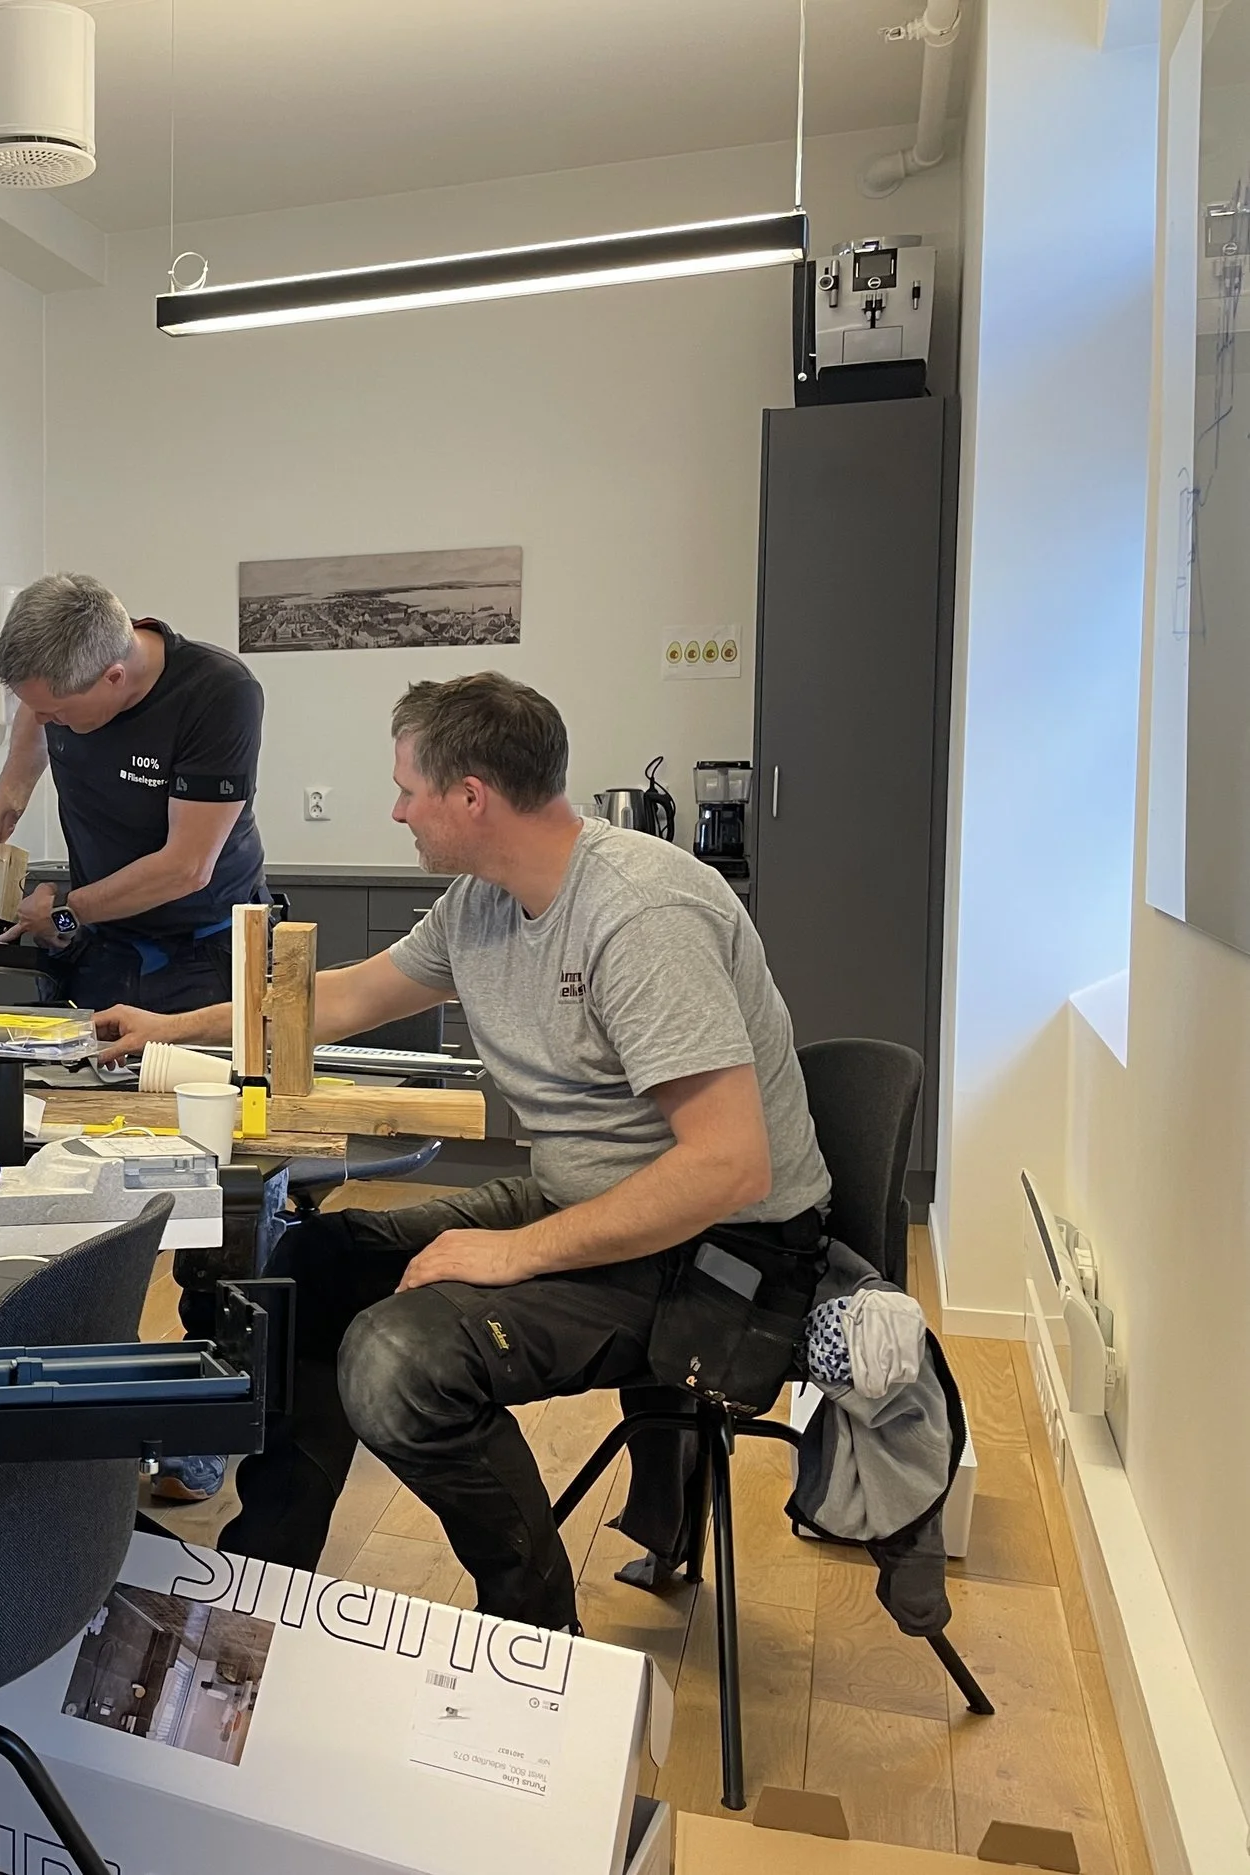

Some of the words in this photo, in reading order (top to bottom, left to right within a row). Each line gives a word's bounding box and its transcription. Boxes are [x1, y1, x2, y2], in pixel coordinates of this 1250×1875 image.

[131, 755, 160, 770] 100%
[502, 1773, 520, 1786] Line
[528, 1769, 548, 1783] Twist
[522, 1779, 546, 1792] Purus
